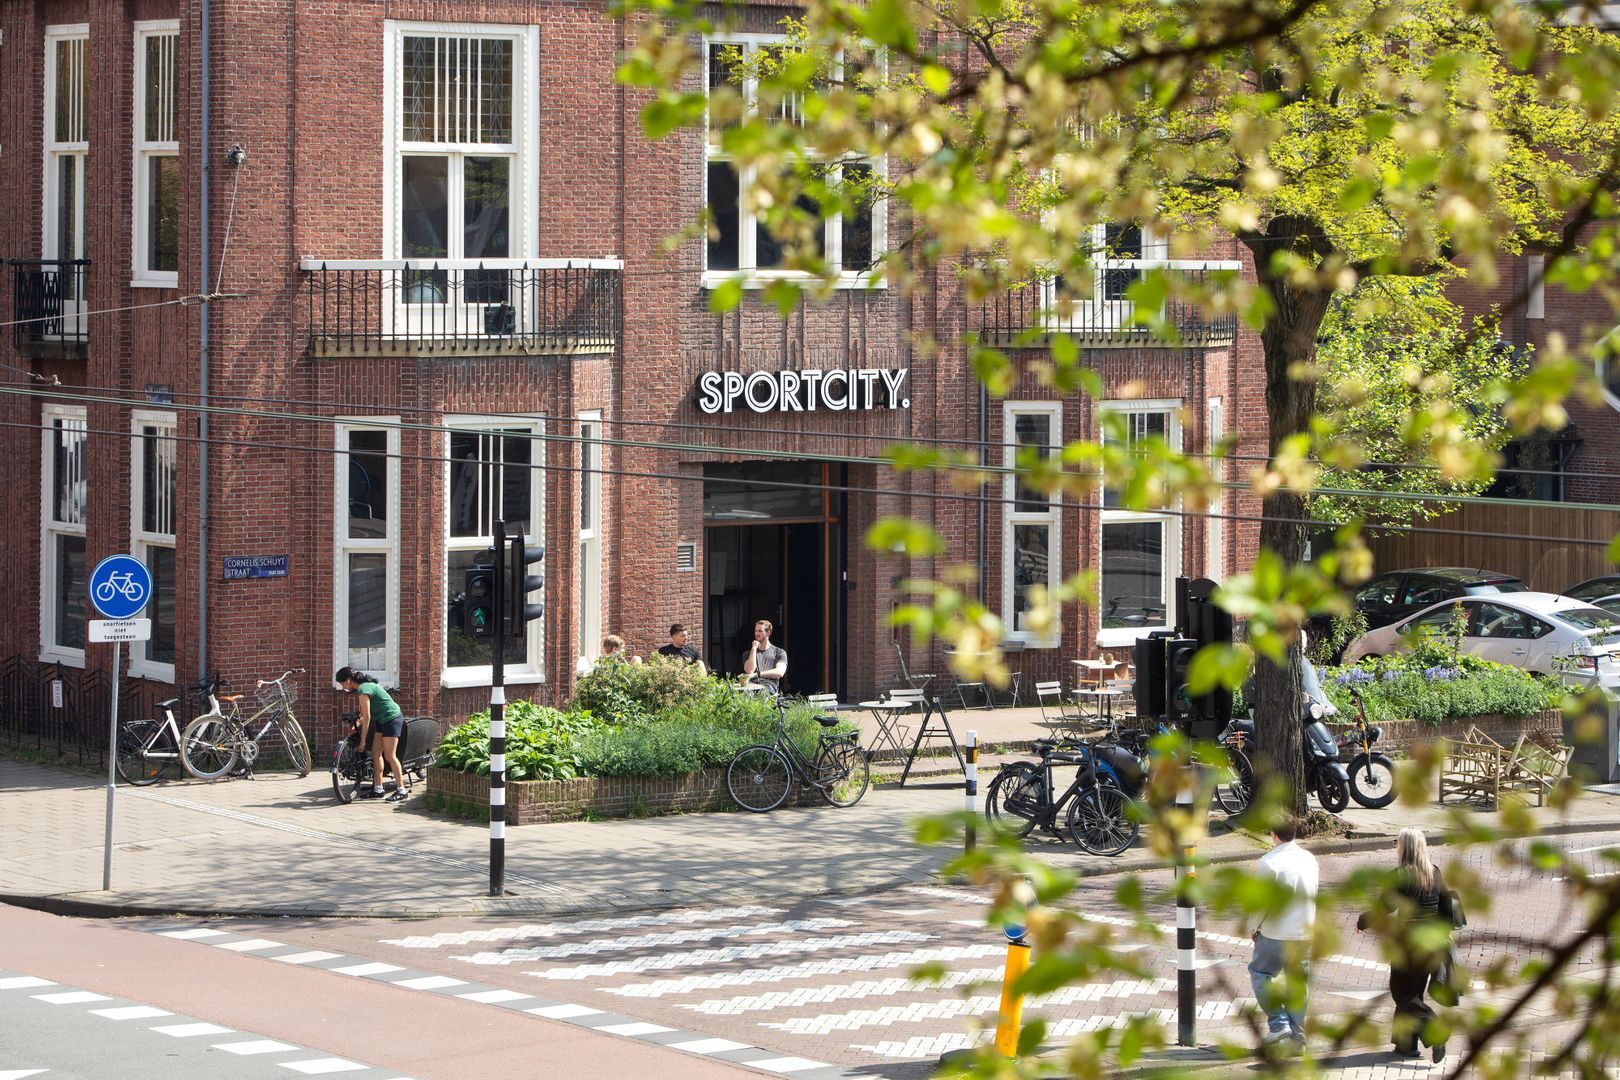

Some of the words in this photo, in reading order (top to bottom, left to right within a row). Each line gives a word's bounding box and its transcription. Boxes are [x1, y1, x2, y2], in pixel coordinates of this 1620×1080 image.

[699, 368, 911, 414] SPORTCITY.
[227, 559, 258, 567] CORNELIS
[260, 558, 284, 566] SCHUYT
[228, 568, 250, 576] STRAAT
